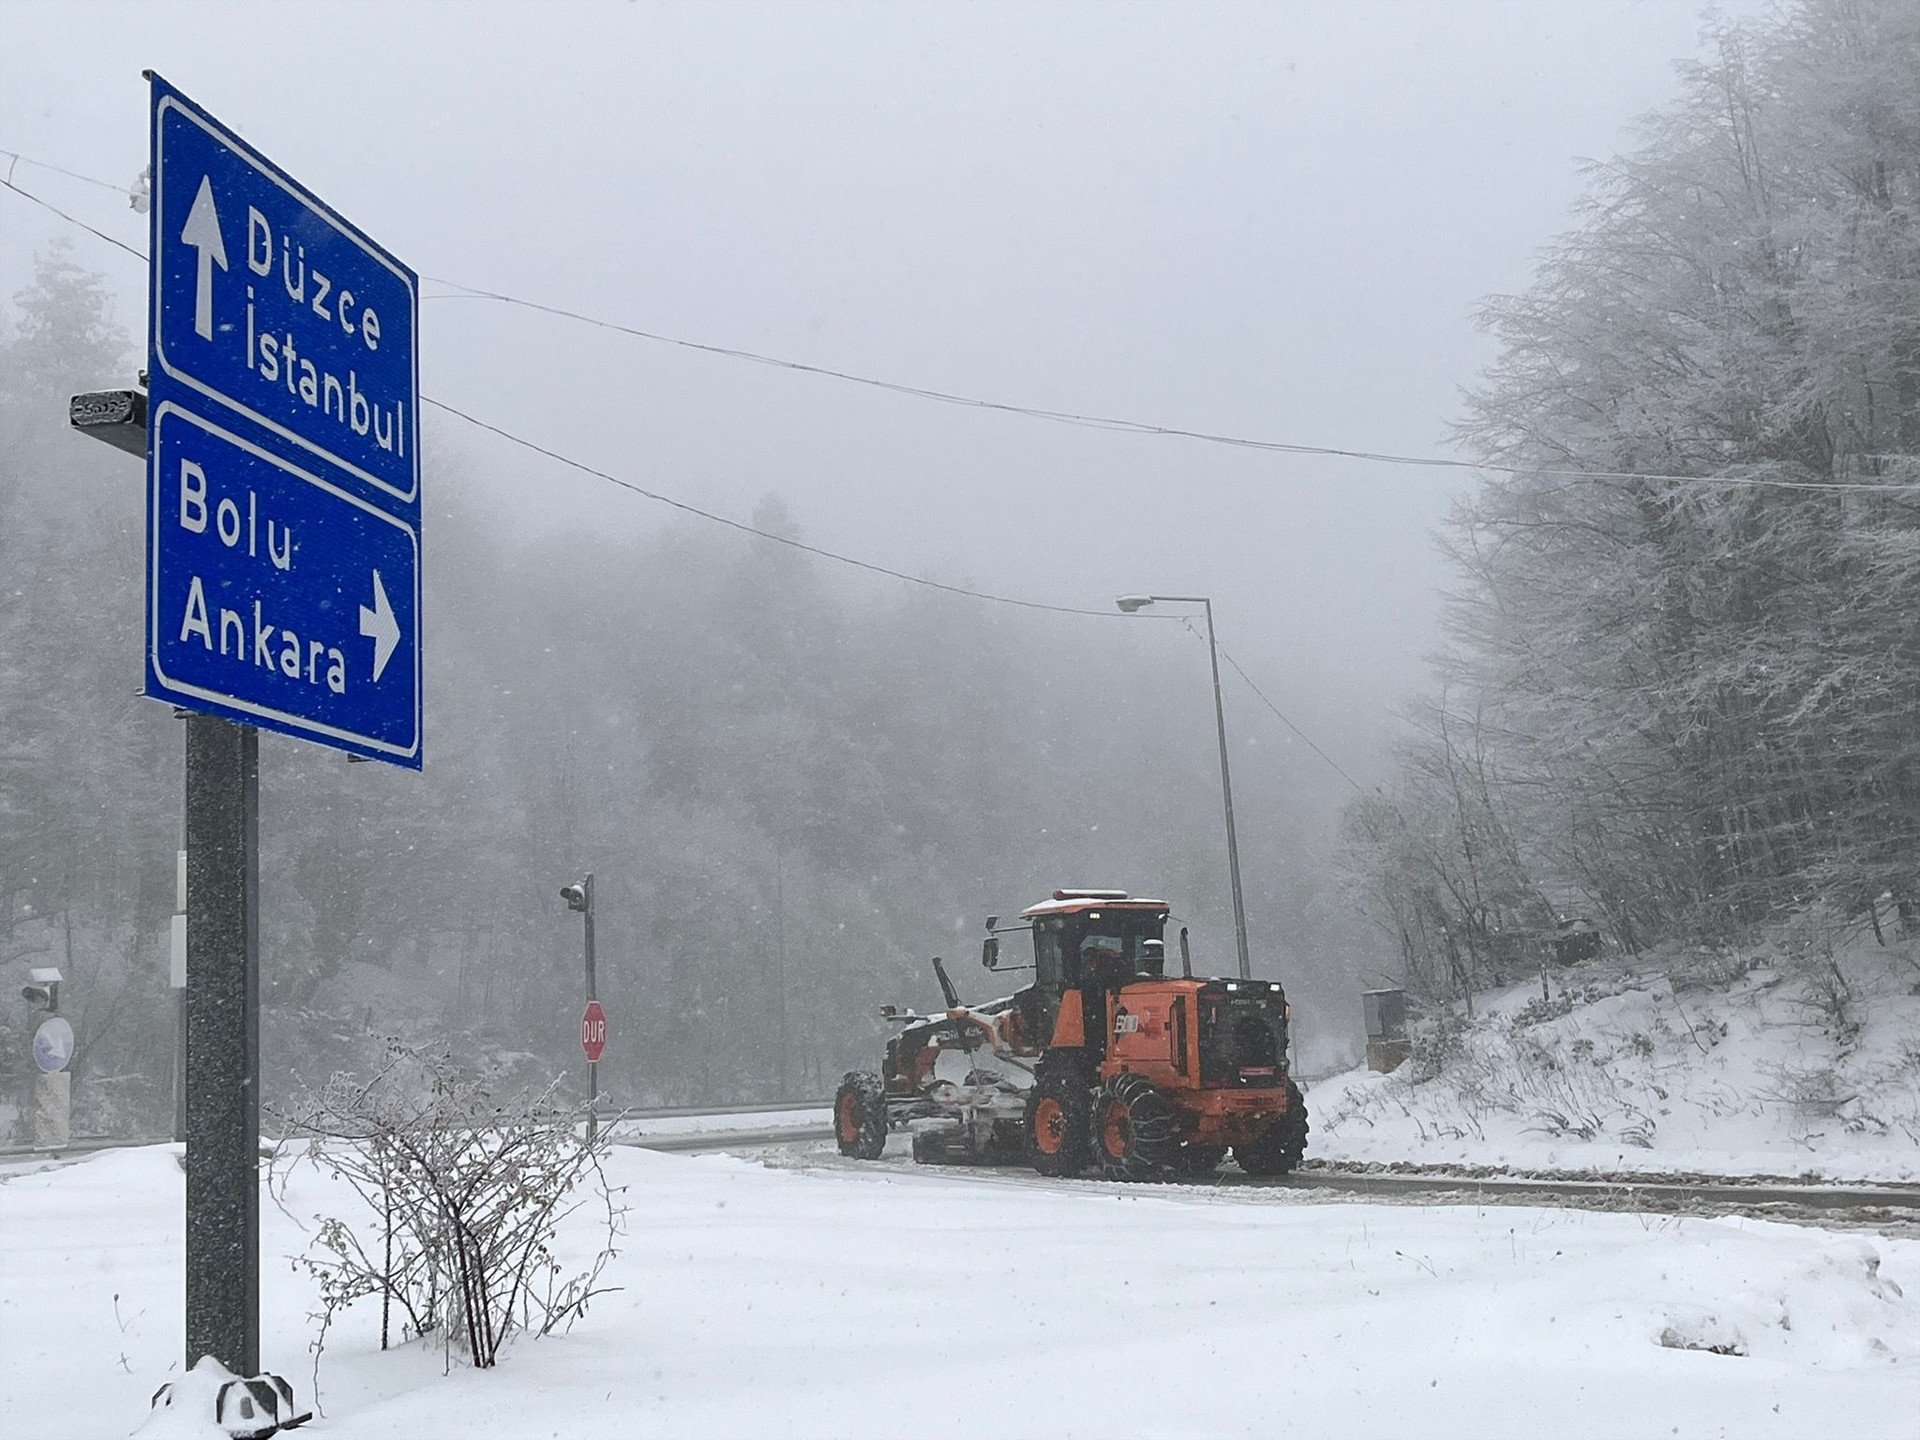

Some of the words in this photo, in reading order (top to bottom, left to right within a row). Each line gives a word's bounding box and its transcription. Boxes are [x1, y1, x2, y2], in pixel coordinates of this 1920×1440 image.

[248, 205, 381, 351] Düzce
[247, 285, 404, 458] İstanbul
[180, 457, 291, 571] Bolu
[179, 575, 346, 694] Ankara
[583, 1020, 605, 1043] DUR
